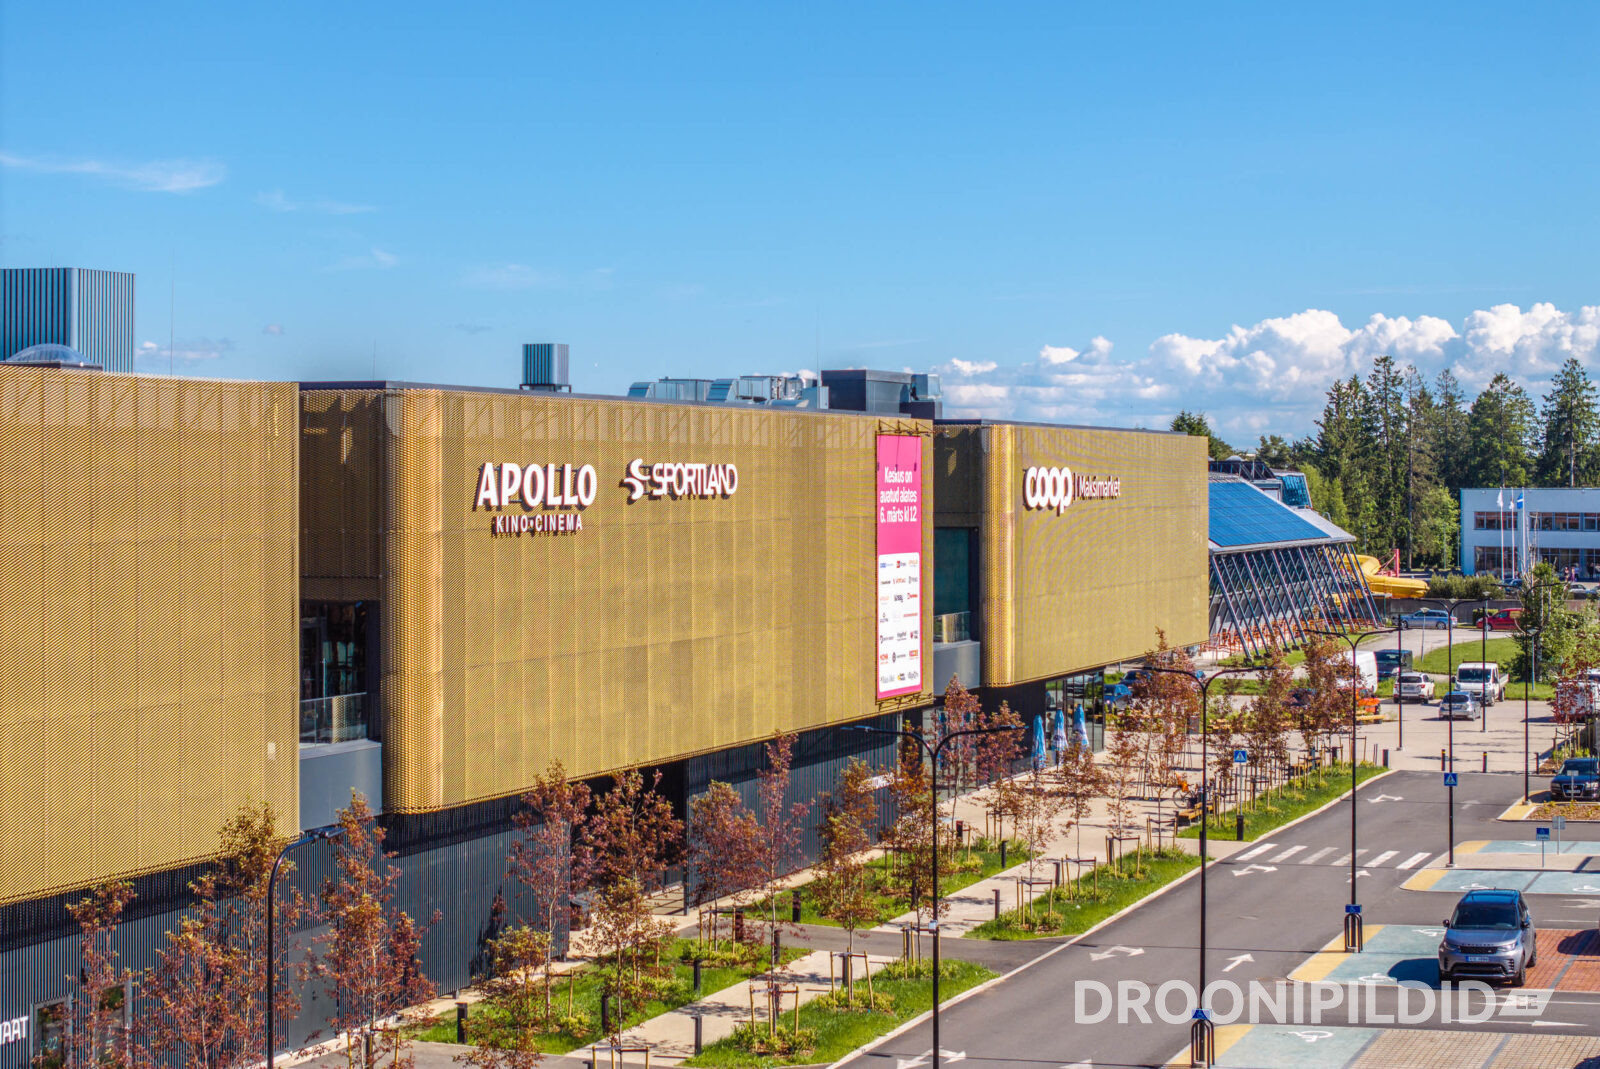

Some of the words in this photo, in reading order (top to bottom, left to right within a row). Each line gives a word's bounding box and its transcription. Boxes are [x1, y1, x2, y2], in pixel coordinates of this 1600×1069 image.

[477, 462, 598, 508] APOLLO
[651, 462, 739, 496] SPORTLAND
[884, 466, 905, 484] Keskus
[904, 471, 913, 484] on
[880, 486, 900, 503] avatud
[899, 486, 918, 503] alates
[1079, 475, 1121, 497] Maksimarket
[886, 506, 904, 523] märts
[909, 505, 917, 522] 12
